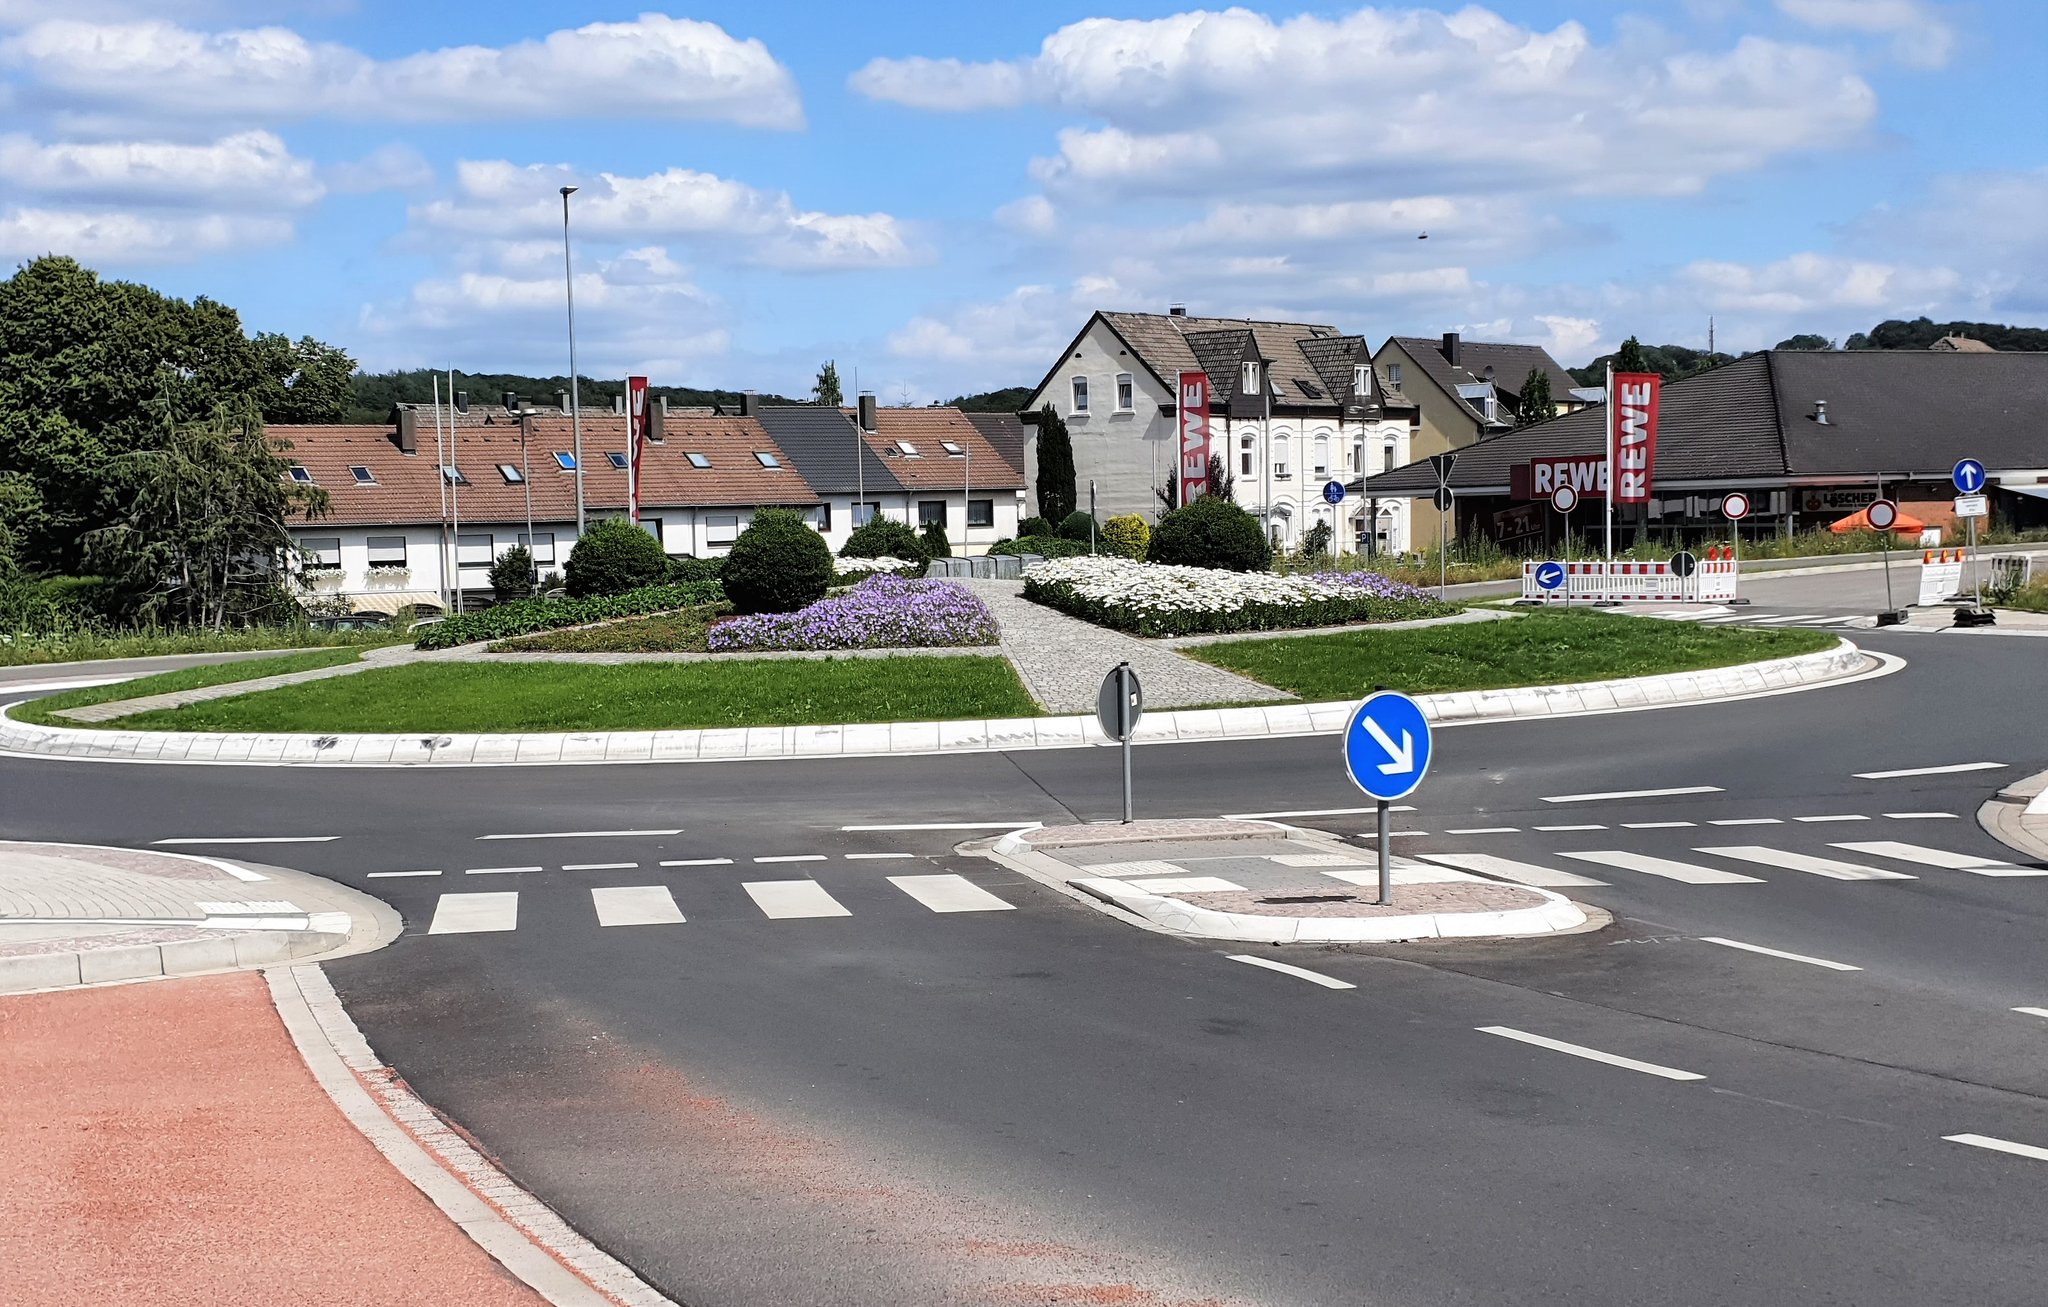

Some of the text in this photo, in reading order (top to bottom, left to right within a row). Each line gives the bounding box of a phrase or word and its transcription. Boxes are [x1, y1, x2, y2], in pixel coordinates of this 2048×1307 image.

[1620, 382, 1651, 498] REWE
[1535, 461, 1607, 493] REWE
[1361, 533, 1367, 543] P
